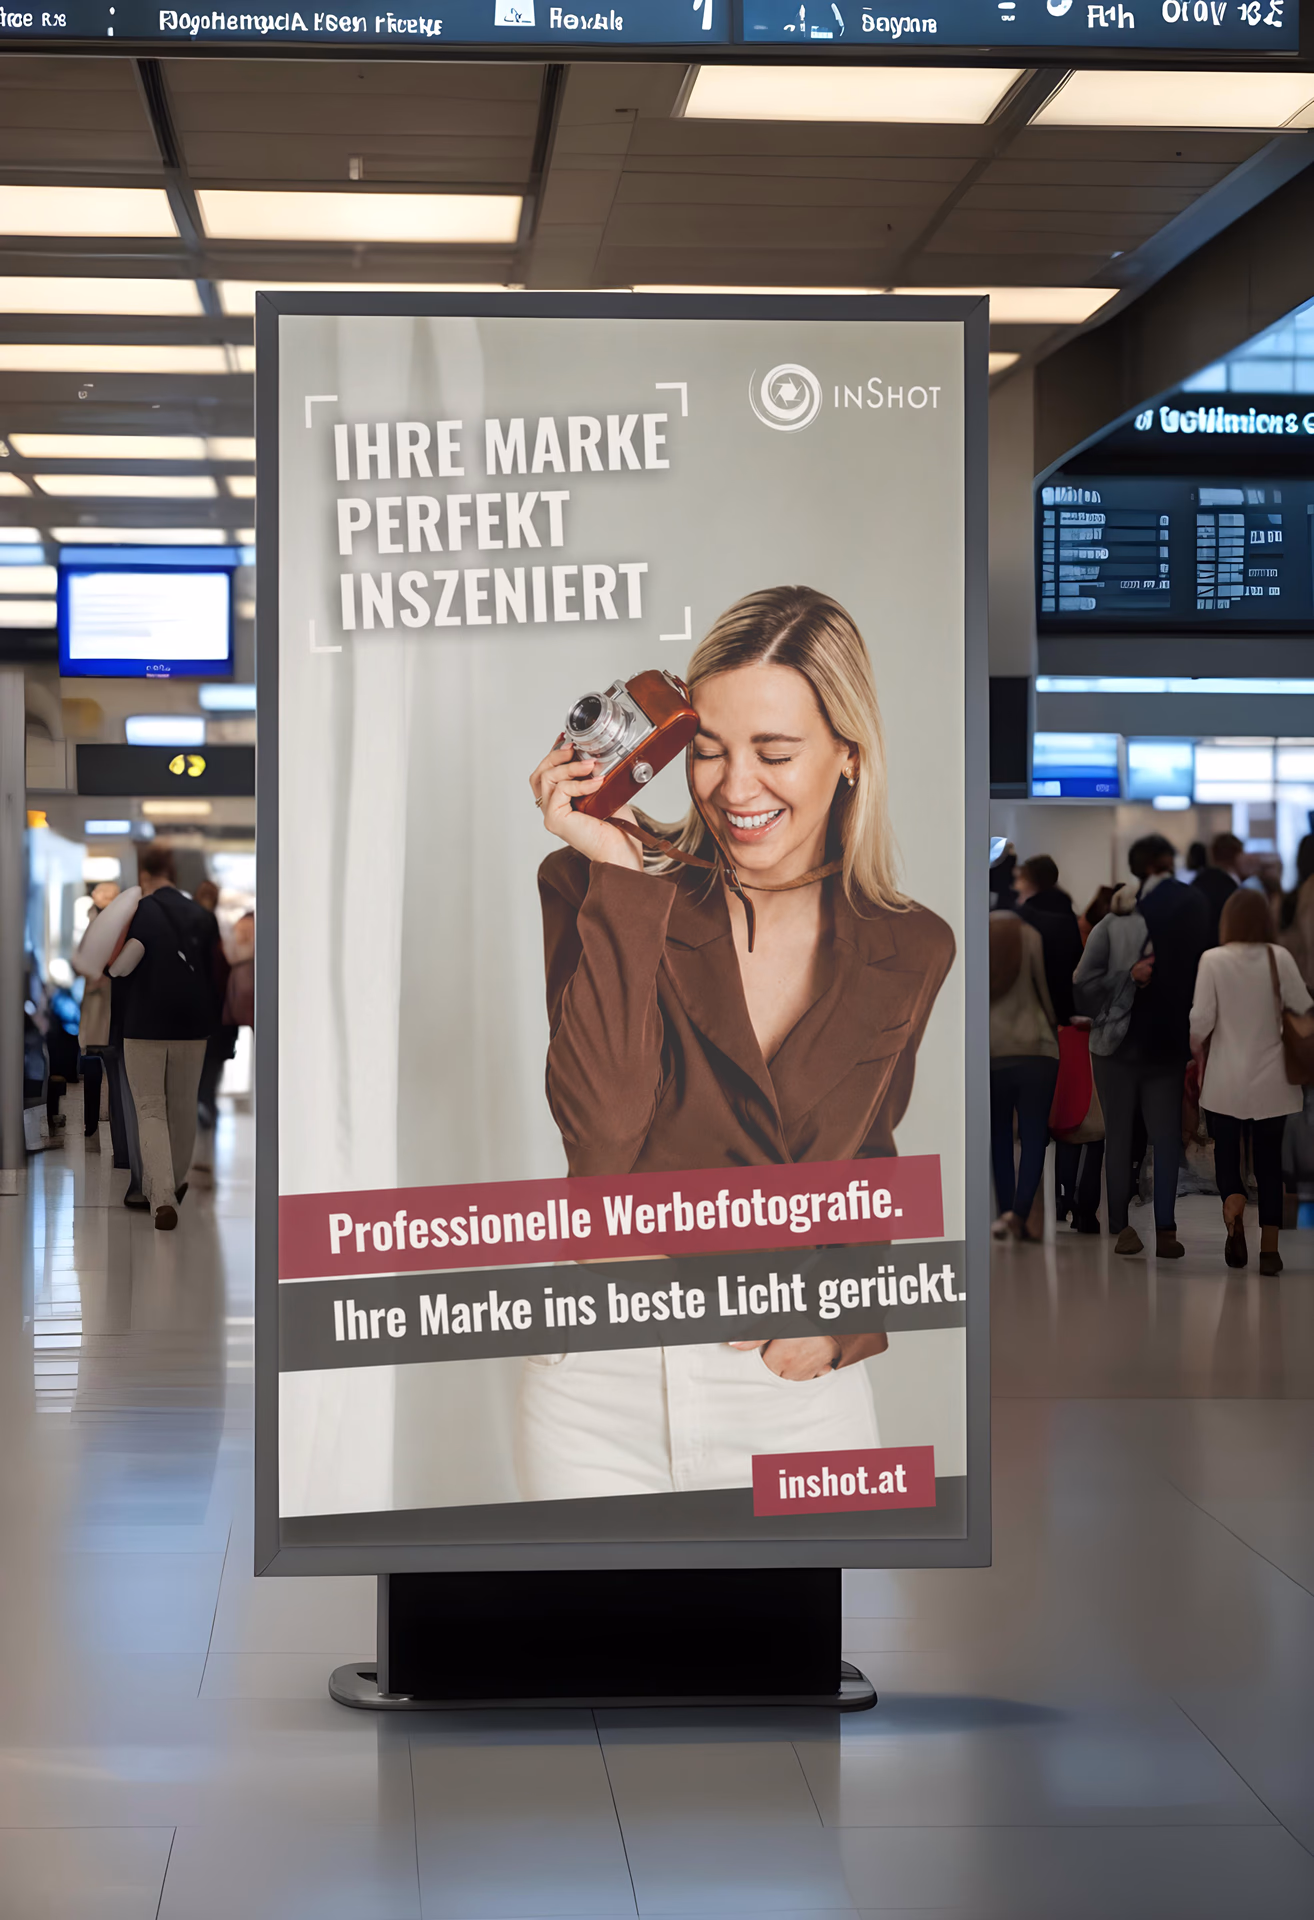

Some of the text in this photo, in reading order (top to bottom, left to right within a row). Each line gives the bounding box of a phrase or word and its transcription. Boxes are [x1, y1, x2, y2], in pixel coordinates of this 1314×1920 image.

[334, 413, 670, 481] IHRE MARKE
[337, 490, 570, 555] PERFEKT
[340, 562, 648, 630] INSZENIERT
[329, 1180, 903, 1254] Professionelle Werbefotografie.
[333, 1263, 967, 1341] Ihre Marke ins beste Licht gerückt.
[779, 1464, 907, 1499] inshot.at
